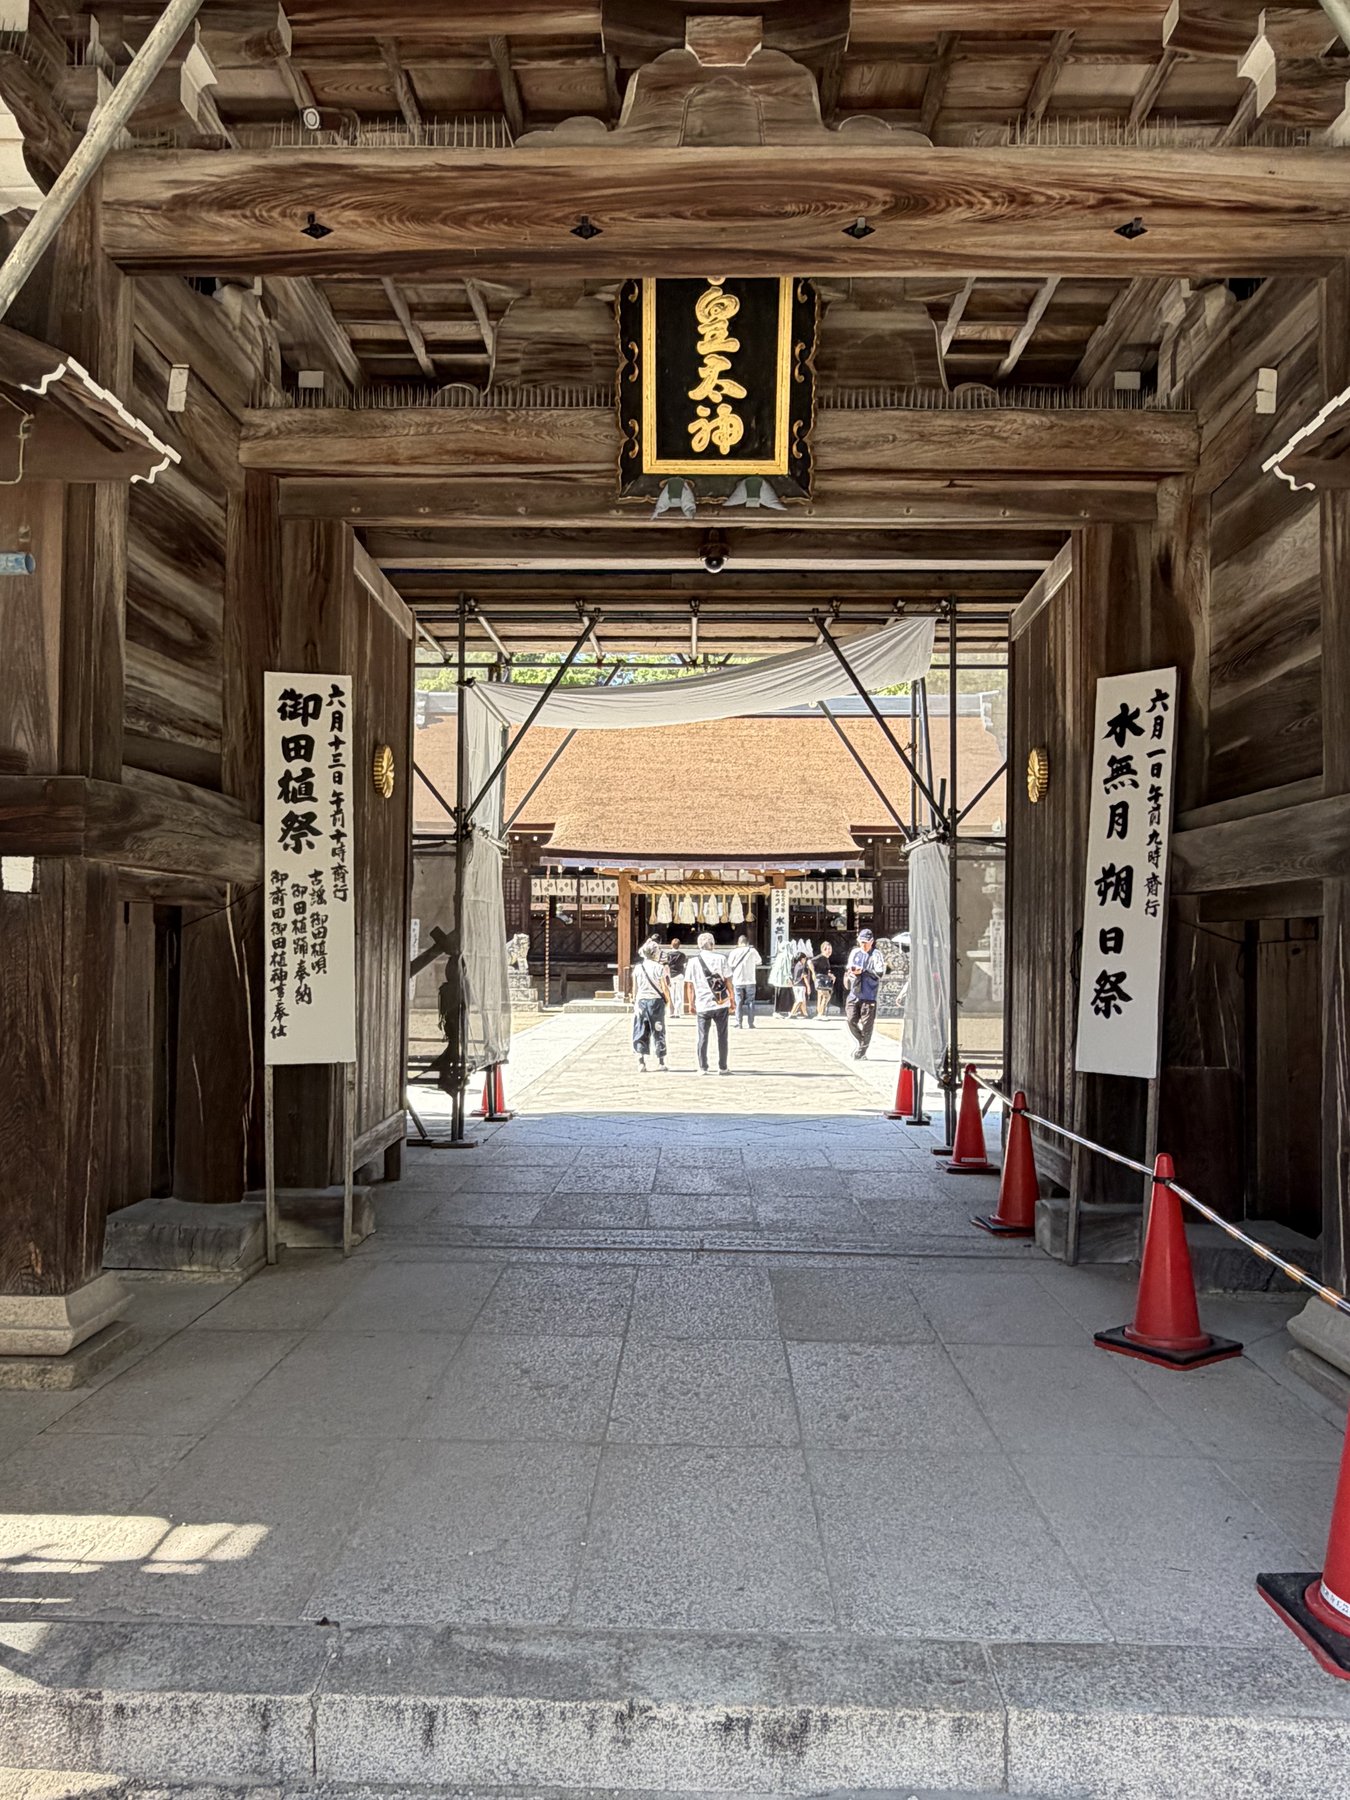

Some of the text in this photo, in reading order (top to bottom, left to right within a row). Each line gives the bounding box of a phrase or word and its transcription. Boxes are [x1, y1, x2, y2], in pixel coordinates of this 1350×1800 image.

[687, 278, 748, 456] 皇太神
[277, 688, 323, 855] 御田植祭
[1090, 702, 1145, 1019] 水無月朔日祭
